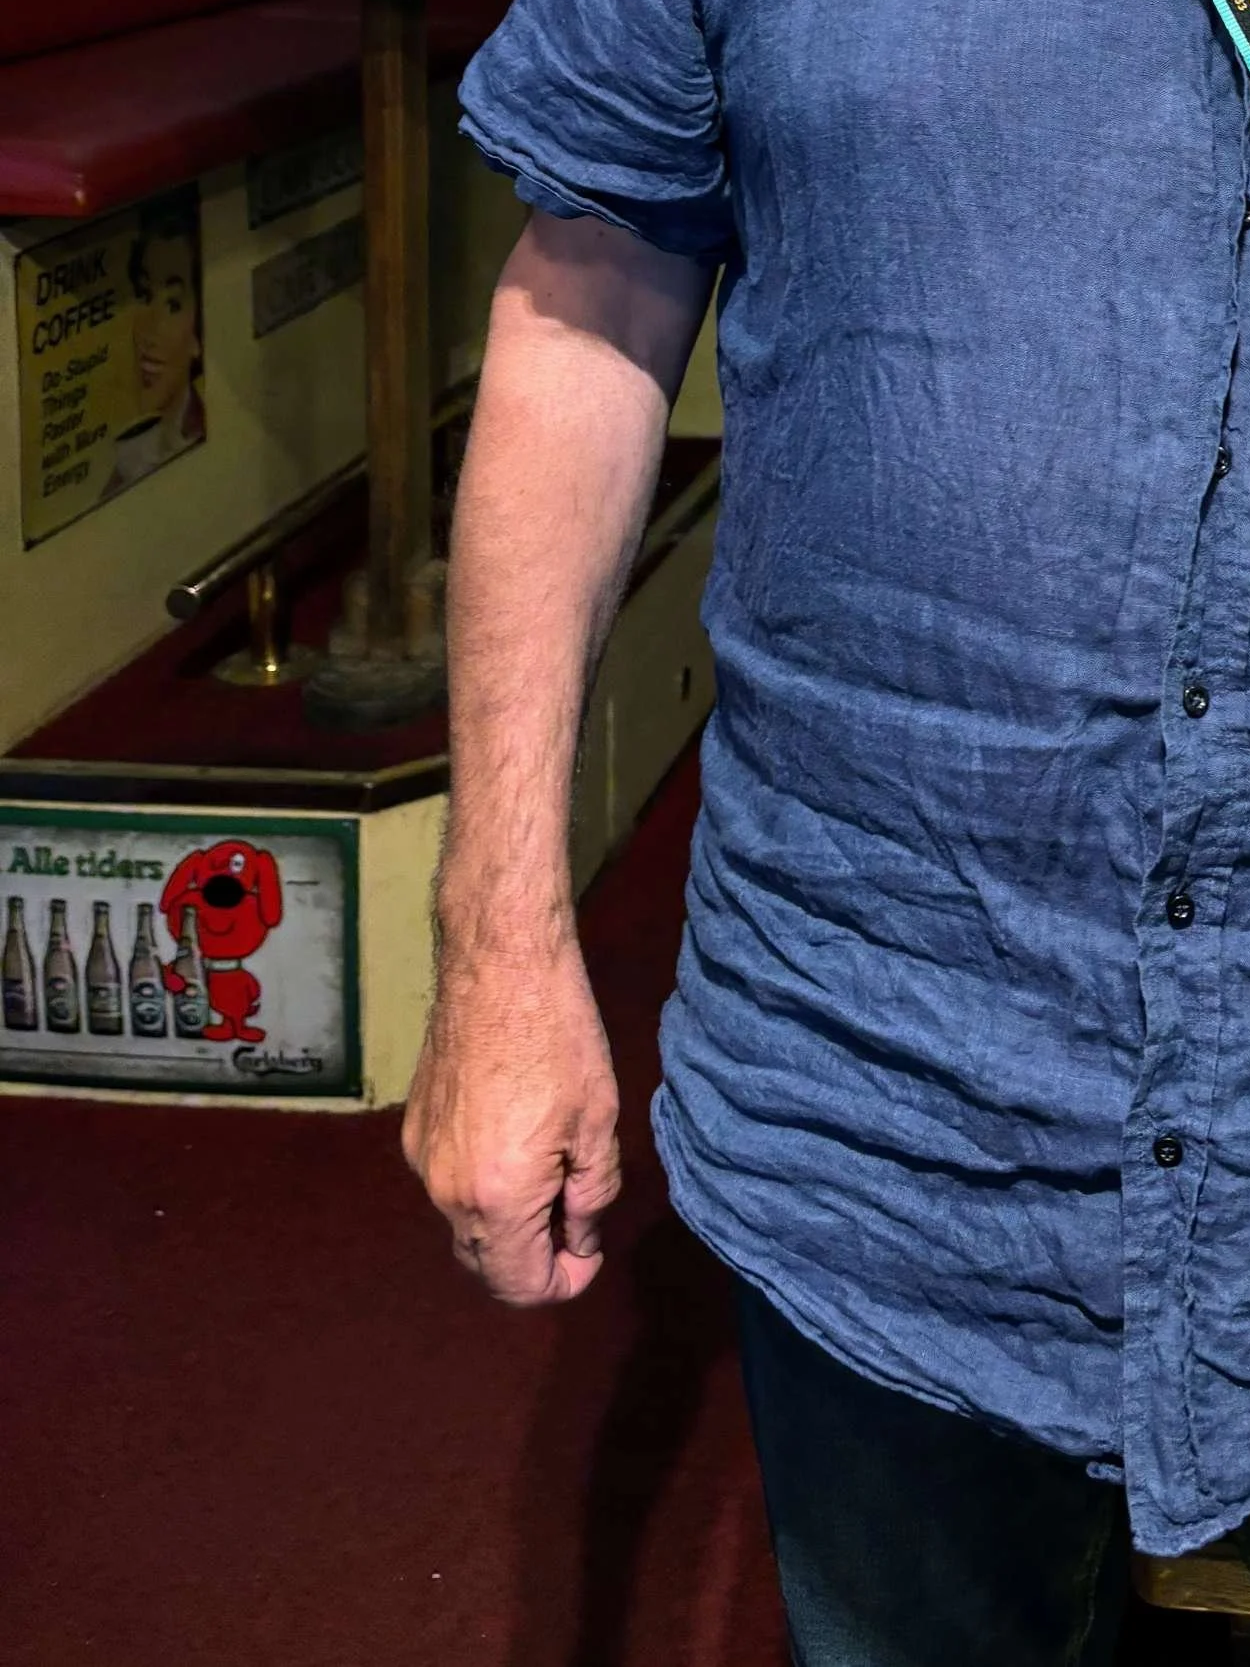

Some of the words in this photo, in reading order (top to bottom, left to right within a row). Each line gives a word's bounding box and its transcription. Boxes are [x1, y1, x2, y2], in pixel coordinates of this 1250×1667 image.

[36, 245, 107, 307] DRINK
[31, 287, 118, 356] COFFEE
[8, 846, 70, 877] Alle
[75, 849, 164, 882] tiders
[232, 1045, 323, 1077] Carlsberg
